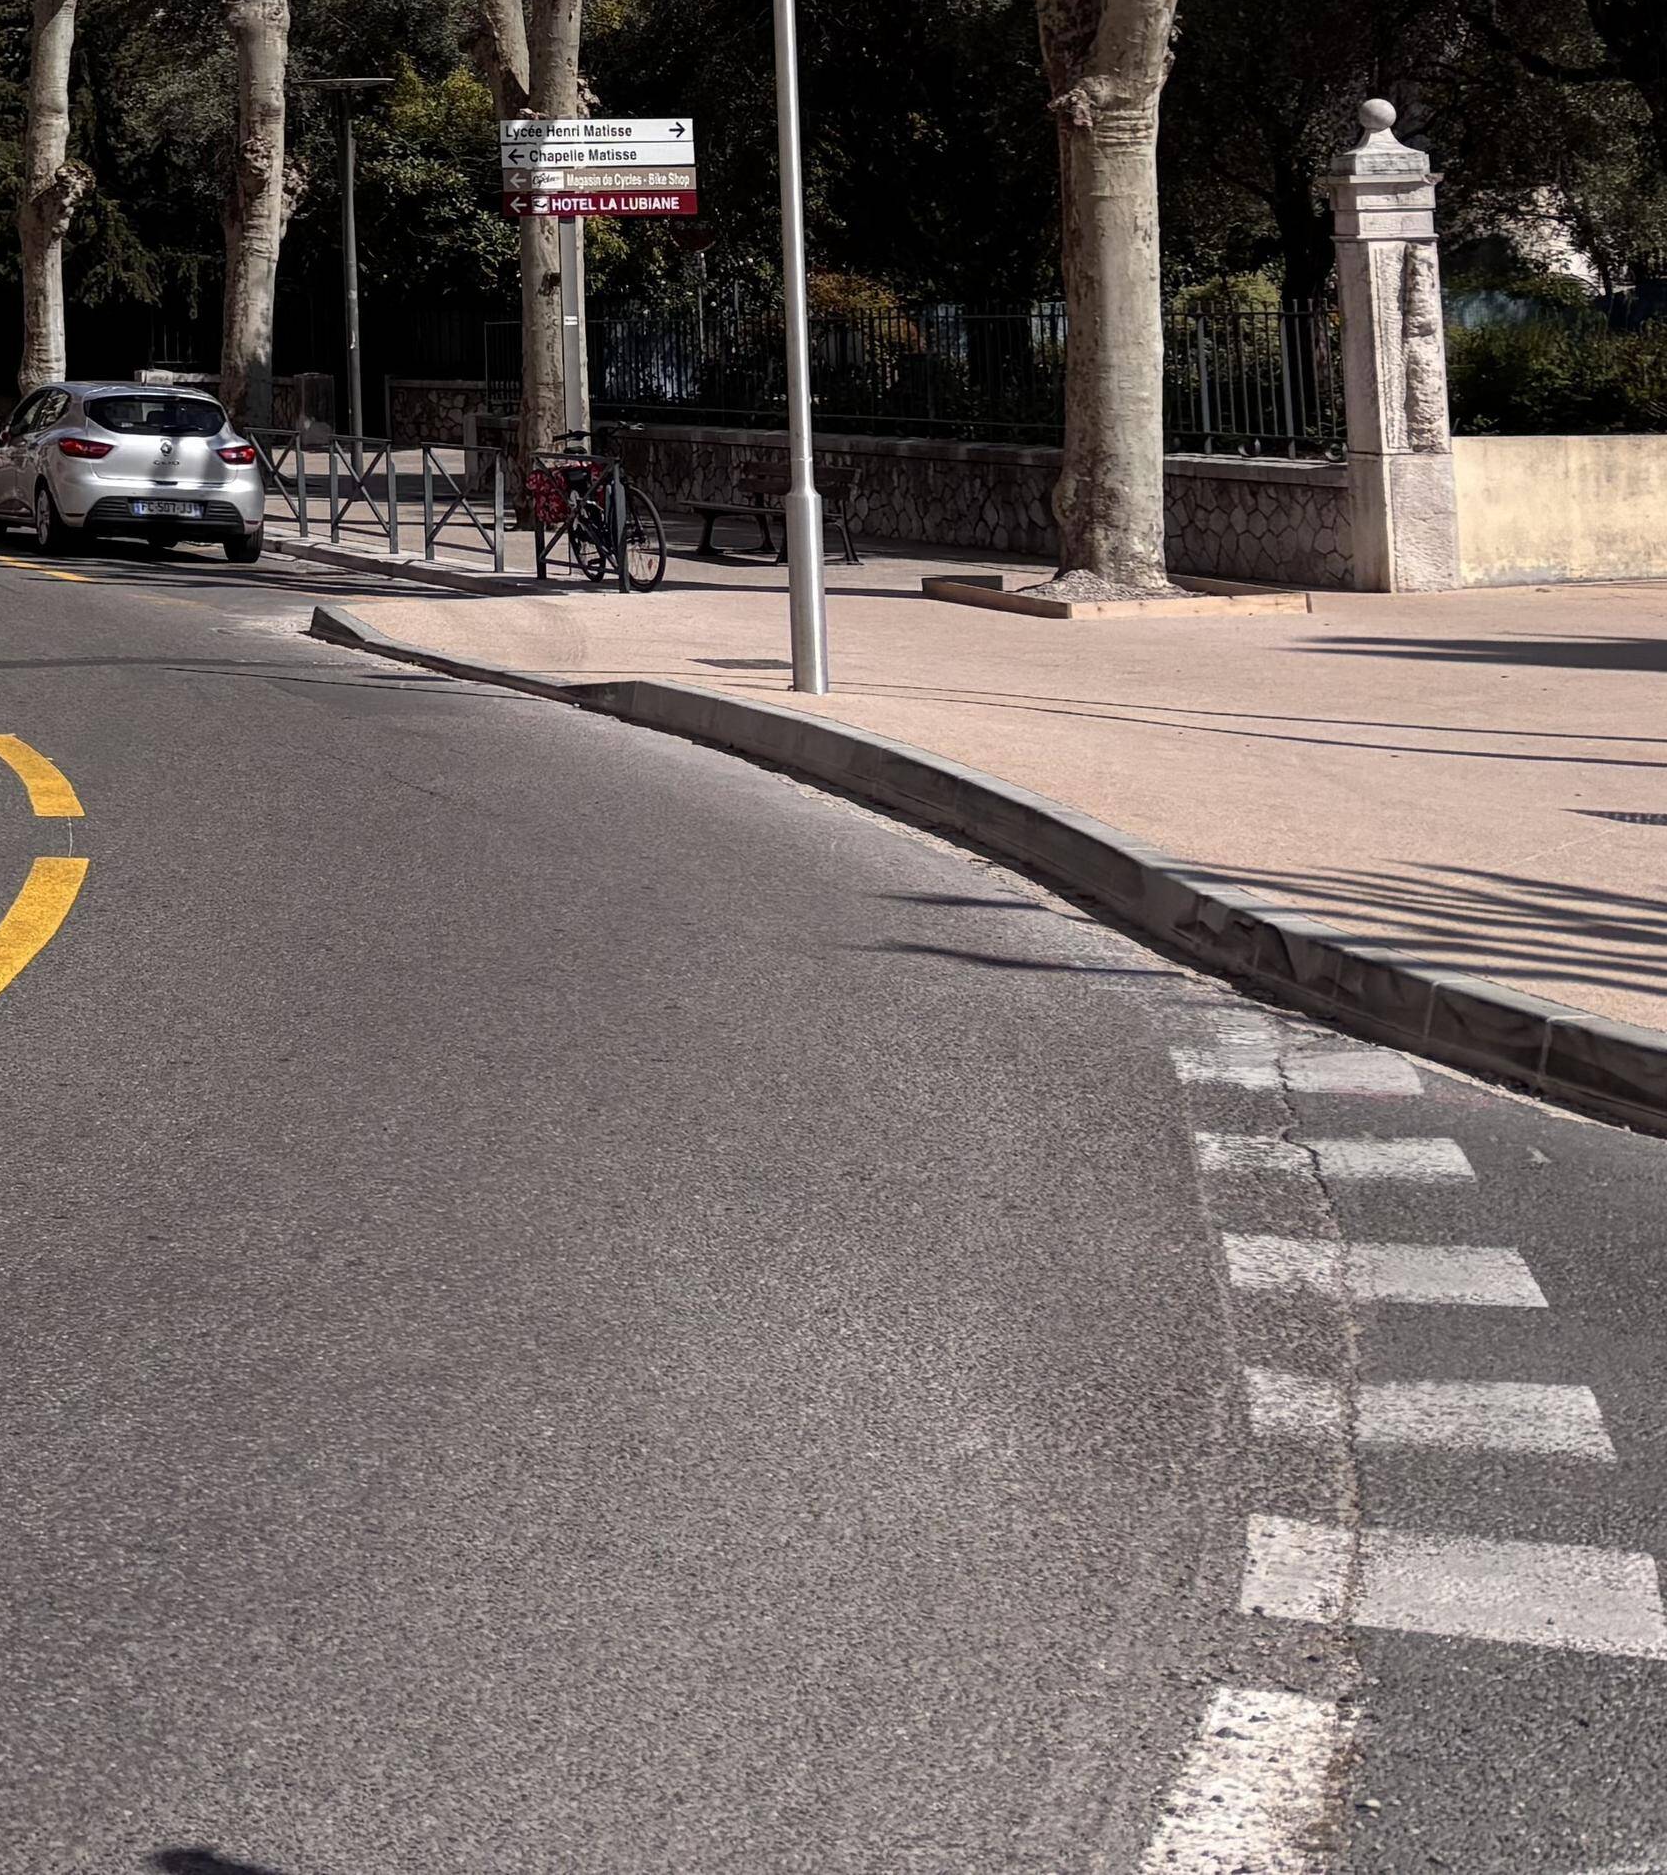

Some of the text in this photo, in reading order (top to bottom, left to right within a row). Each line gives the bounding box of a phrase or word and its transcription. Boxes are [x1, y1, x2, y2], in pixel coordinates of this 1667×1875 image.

[505, 123, 632, 140] Lycée Henri Matisse
[529, 148, 637, 163] Chapelle Matisse
[566, 173, 601, 189] Magasin
[602, 173, 613, 186] de
[614, 172, 643, 188] Cycles
[648, 172, 667, 185] Bike
[668, 172, 690, 187] Shop
[551, 196, 680, 211] HOTEL LA LUBIANE
